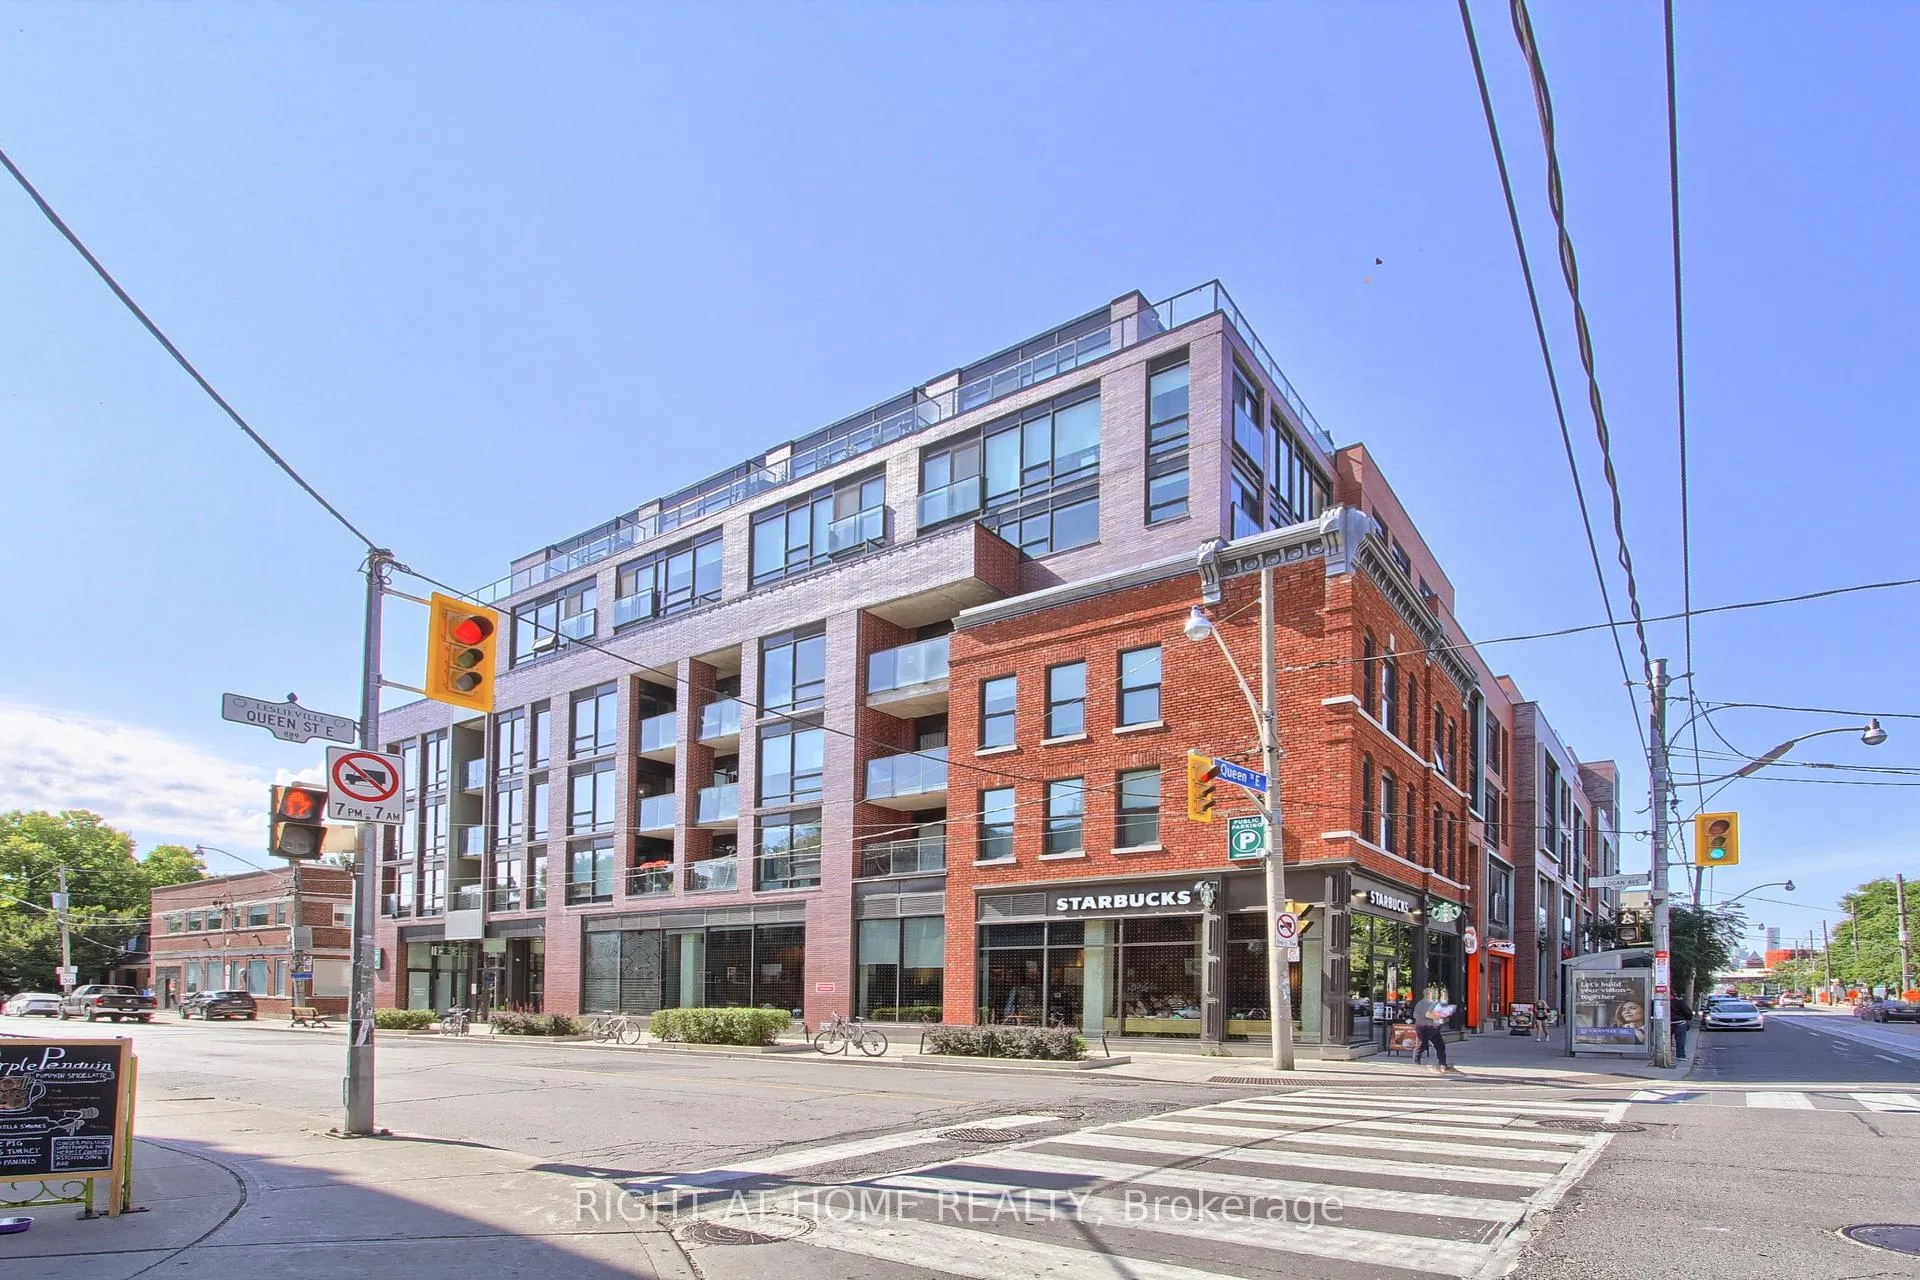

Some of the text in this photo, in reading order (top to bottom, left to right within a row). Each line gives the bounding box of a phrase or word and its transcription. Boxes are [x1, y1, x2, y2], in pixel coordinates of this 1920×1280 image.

[256, 703, 327, 723] LESLIEVILLE
[246, 710, 334, 737] QUEEN ST E
[1220, 763, 1247, 783] Queen
[1255, 775, 1260, 787] E
[1231, 822, 1263, 830] PARKING
[1240, 832, 1256, 849] P
[1056, 890, 1191, 911] STARBUCKS
[1369, 890, 1409, 914] STARBUCKS
[7, 1147, 41, 1155] TURKEY
[3, 1158, 37, 1166] PANINIS
